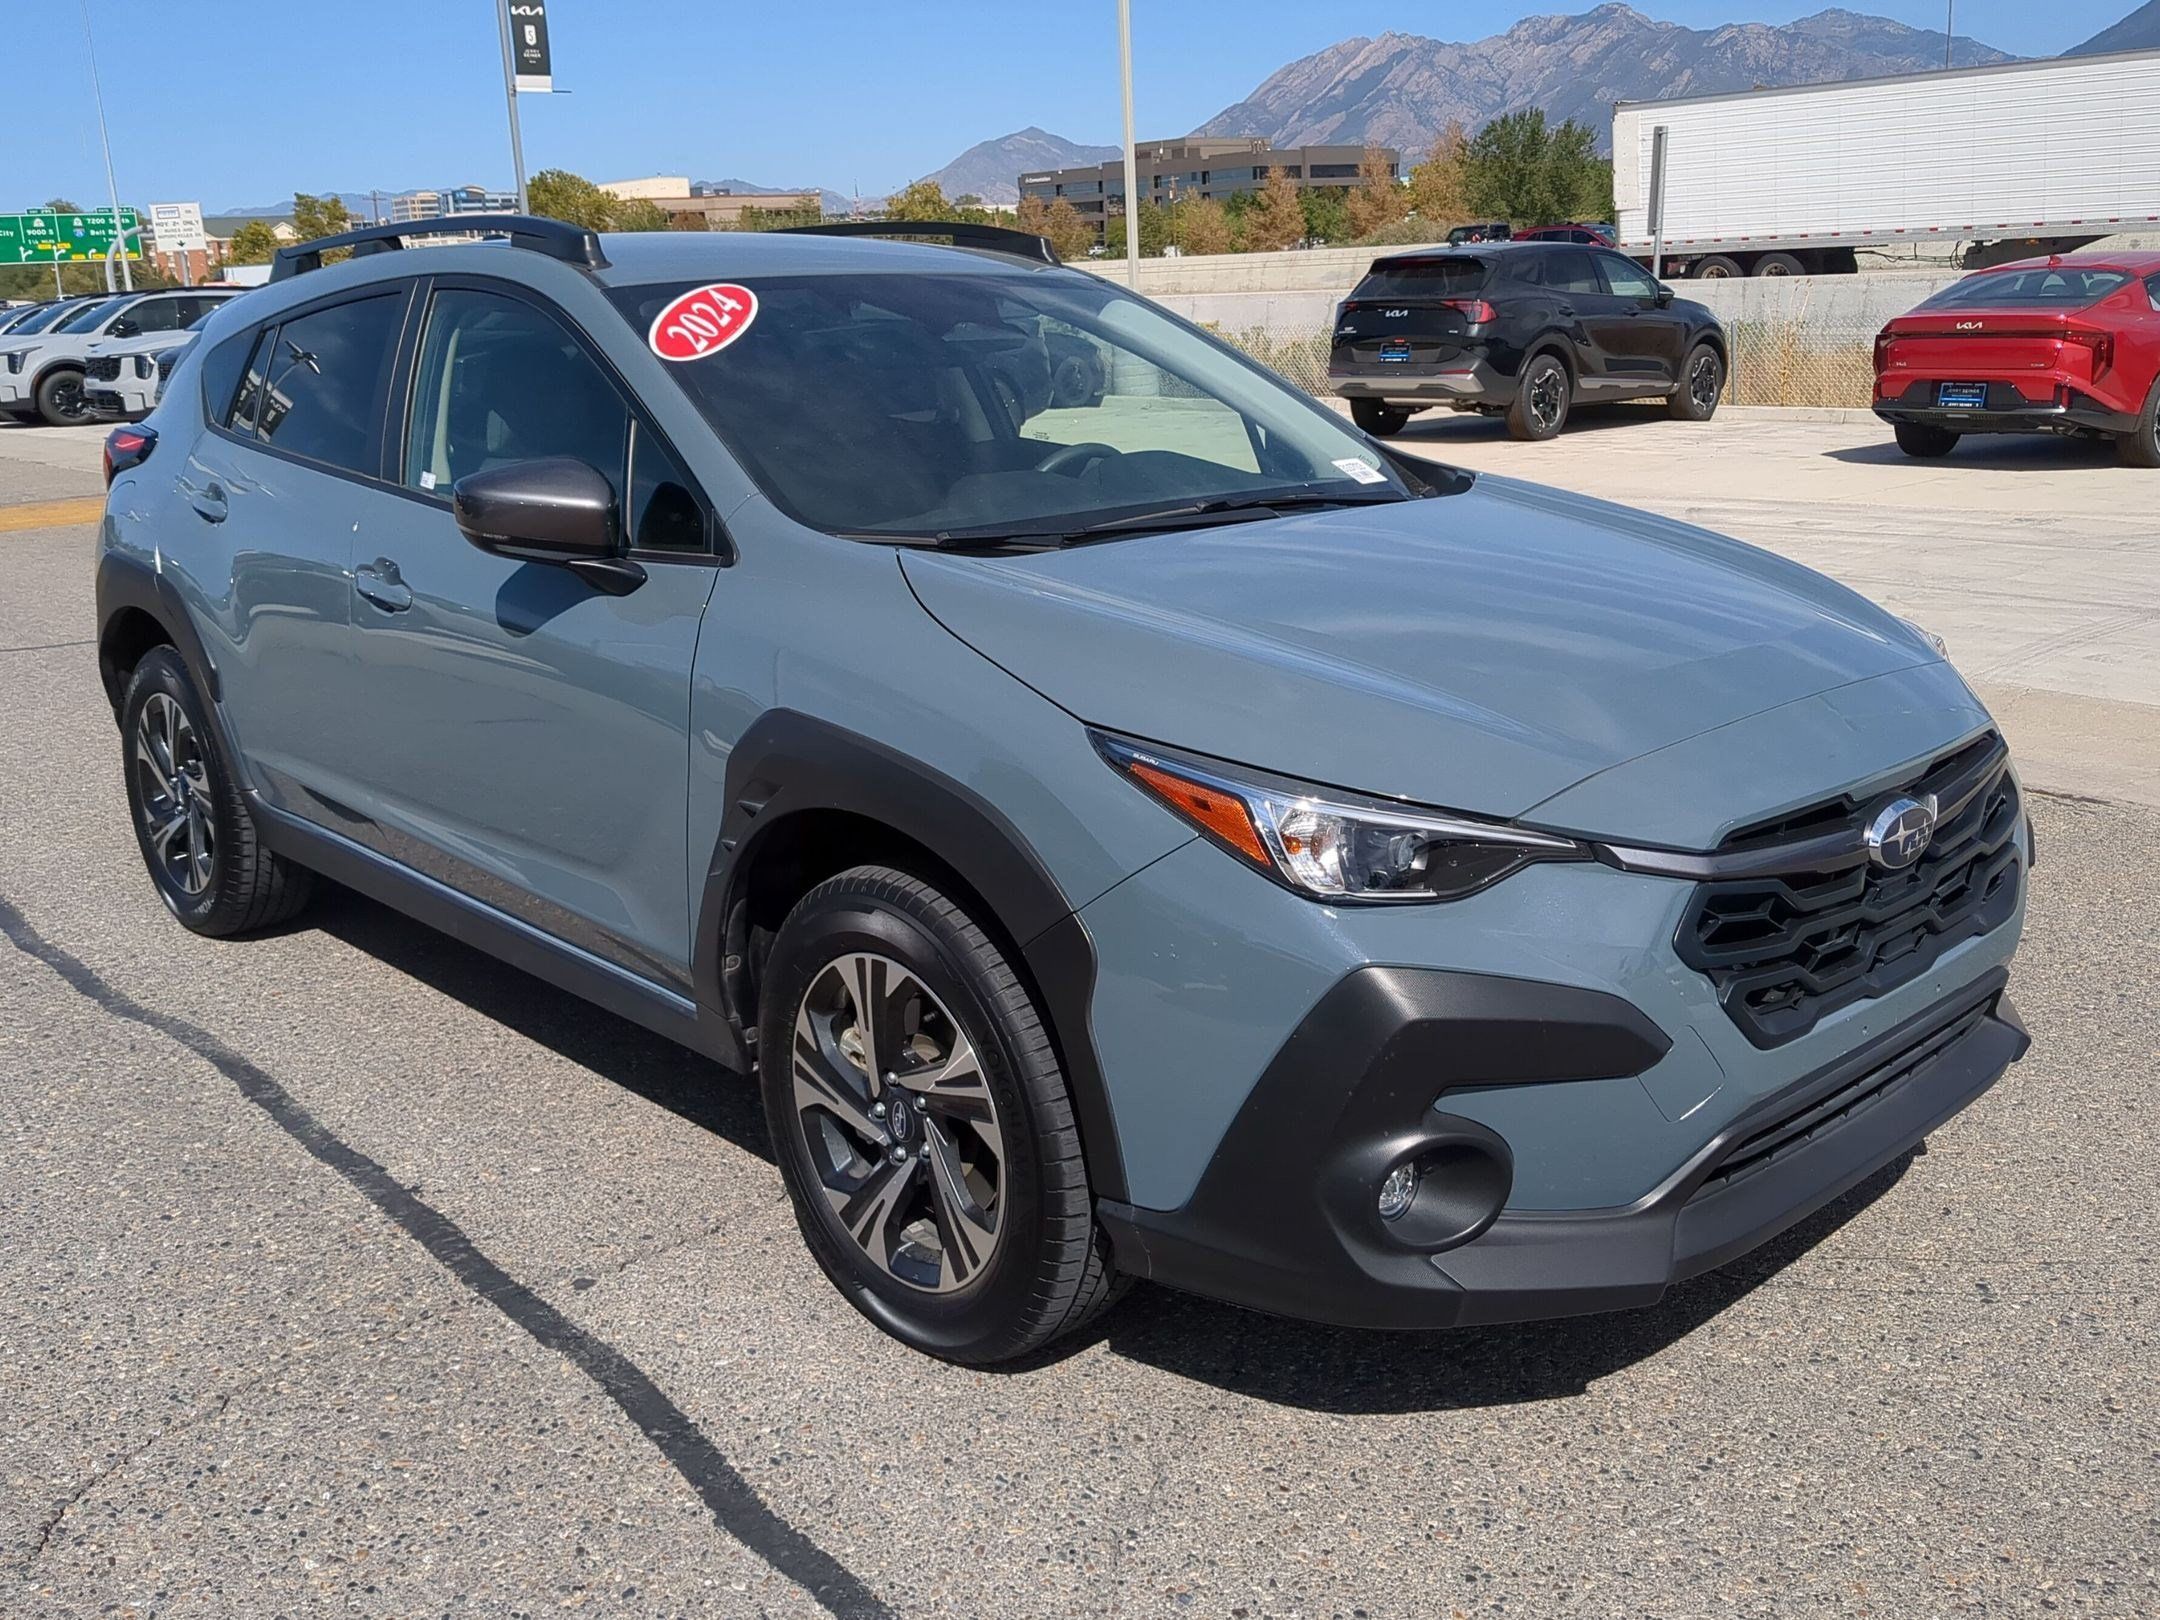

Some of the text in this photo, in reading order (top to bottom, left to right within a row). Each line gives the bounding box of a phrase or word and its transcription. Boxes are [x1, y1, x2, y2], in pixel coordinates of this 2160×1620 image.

[511, 5, 544, 16] KIA
[667, 288, 743, 353] 2024
[1956, 321, 1983, 329] KIA
[1132, 752, 1159, 766] SUBARU
